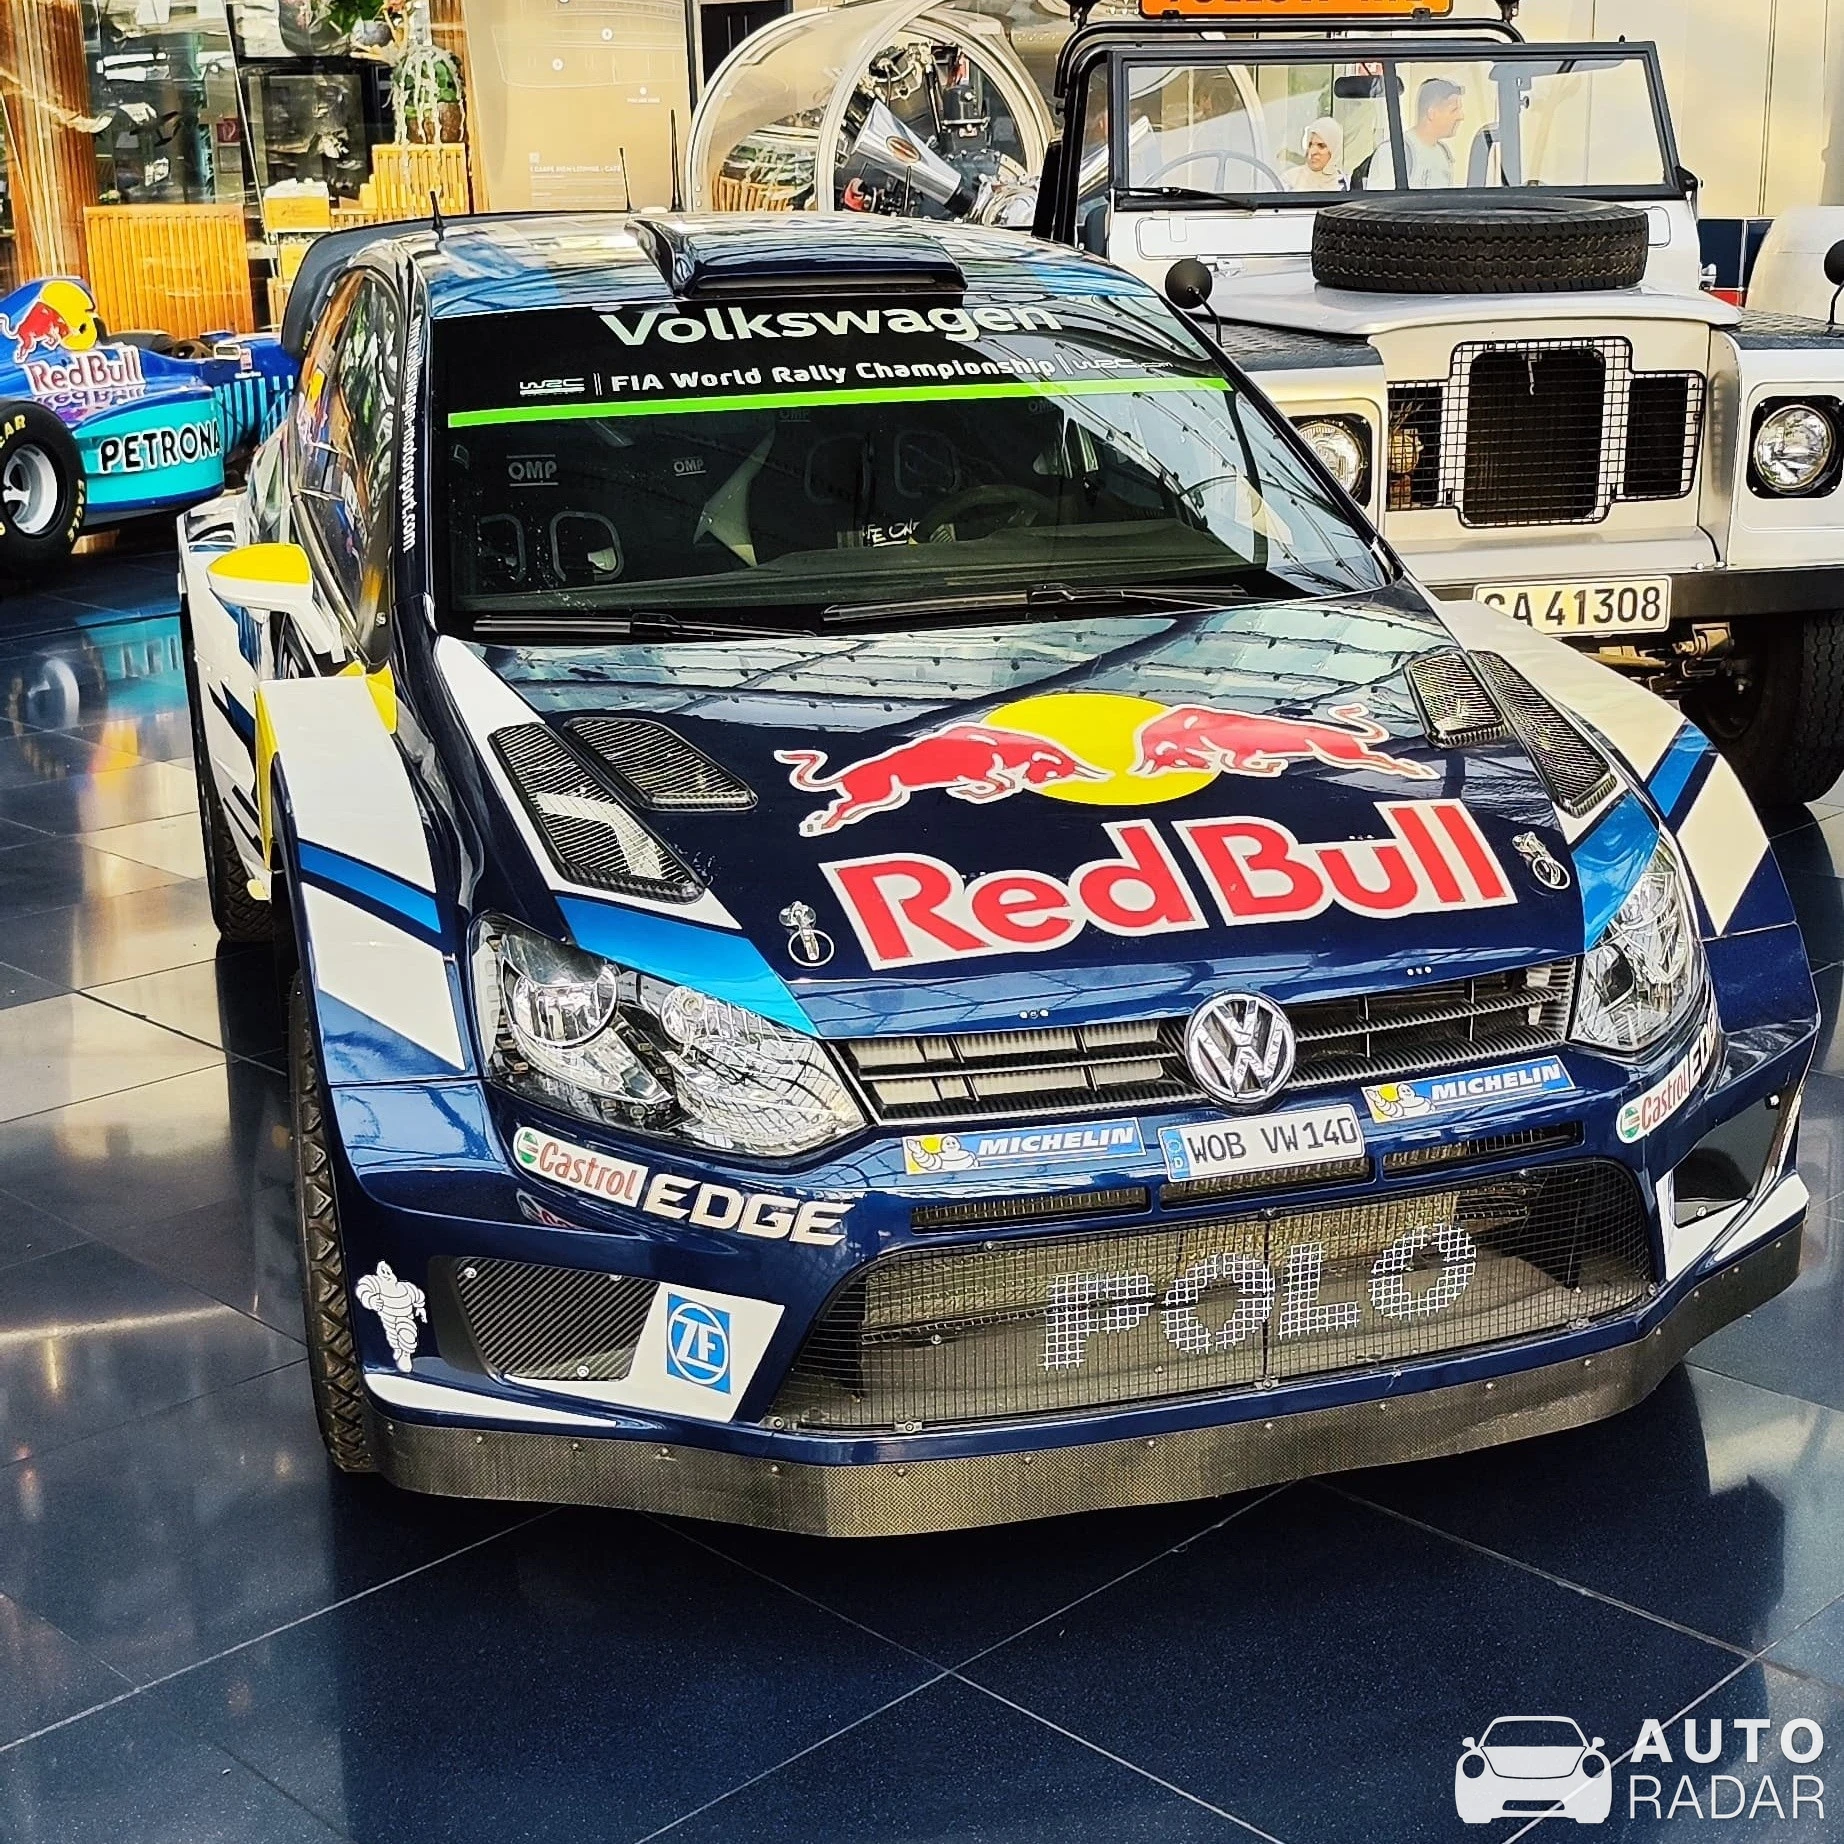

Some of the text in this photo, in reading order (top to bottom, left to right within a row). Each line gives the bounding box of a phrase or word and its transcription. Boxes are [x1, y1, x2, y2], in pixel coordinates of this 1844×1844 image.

[600, 305, 1063, 345] Volkswagen
[28, 348, 142, 393] Red Bull
[611, 375, 664, 392] FIA
[669, 367, 762, 389] World
[771, 364, 847, 383] Rally
[855, 358, 1057, 380] Championship
[0, 414, 27, 449] AR
[508, 460, 557, 479] OMP
[674, 458, 706, 475] OMP
[1545, 586, 1661, 626] 41308
[824, 800, 1516, 968] Red Bull
[1430, 1063, 1563, 1100] MICHELIN
[1641, 1062, 1688, 1131] Castrol
[978, 1127, 1134, 1157] MICHELIN
[1173, 1157, 1184, 1169] D
[1187, 1132, 1246, 1164] WOB
[1260, 1123, 1299, 1154] VW
[539, 1141, 856, 1246] Castrol EDGE
[1039, 1221, 1478, 1371] POLO
[672, 1313, 725, 1373] ZF
